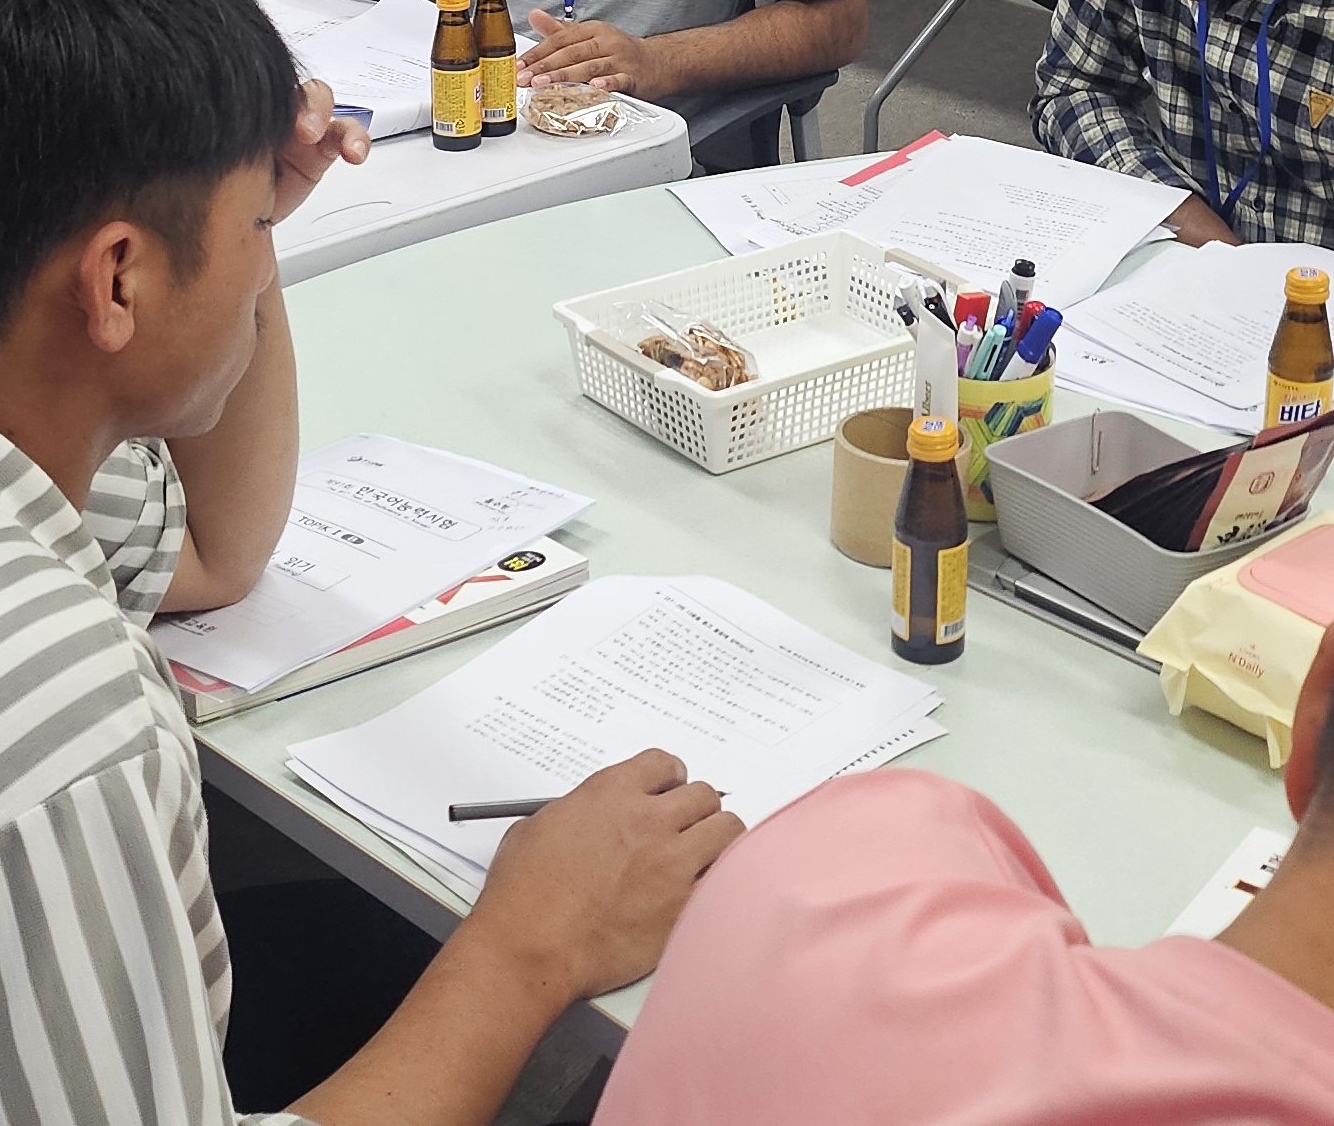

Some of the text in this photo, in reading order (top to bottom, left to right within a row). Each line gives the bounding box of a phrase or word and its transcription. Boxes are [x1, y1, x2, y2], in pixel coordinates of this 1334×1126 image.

[1279, 399, 1321, 422] 비타
[356, 484, 458, 531] 한국어능력시험
[297, 514, 332, 534] TOPIK
[284, 554, 316, 574] 읽기
